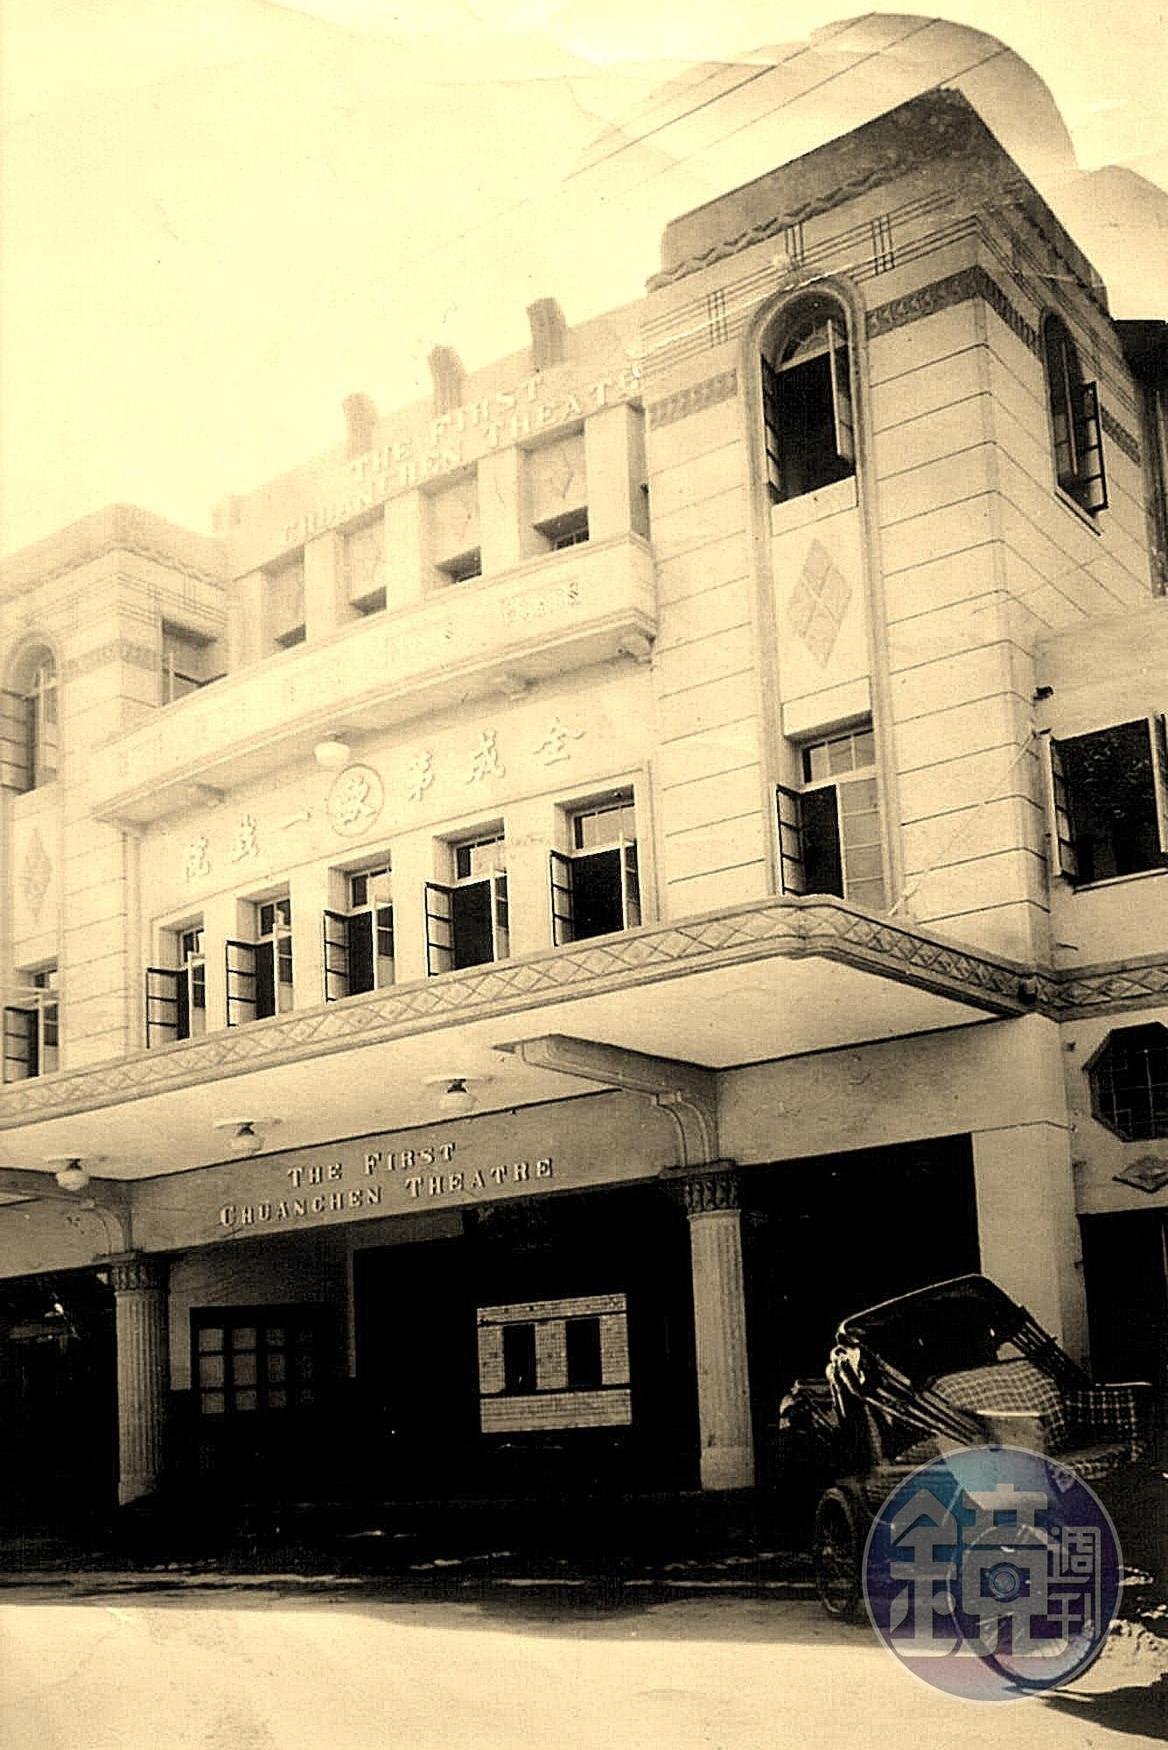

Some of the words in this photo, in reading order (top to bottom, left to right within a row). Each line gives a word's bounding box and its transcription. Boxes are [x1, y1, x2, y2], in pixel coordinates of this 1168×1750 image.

[430, 372, 544, 446] FIRST
[218, 1185, 383, 1229] CHUANCHEN
[405, 1157, 554, 1200] THEATRE
[287, 1162, 344, 1189] THE
[362, 1142, 457, 1177] FIRST
